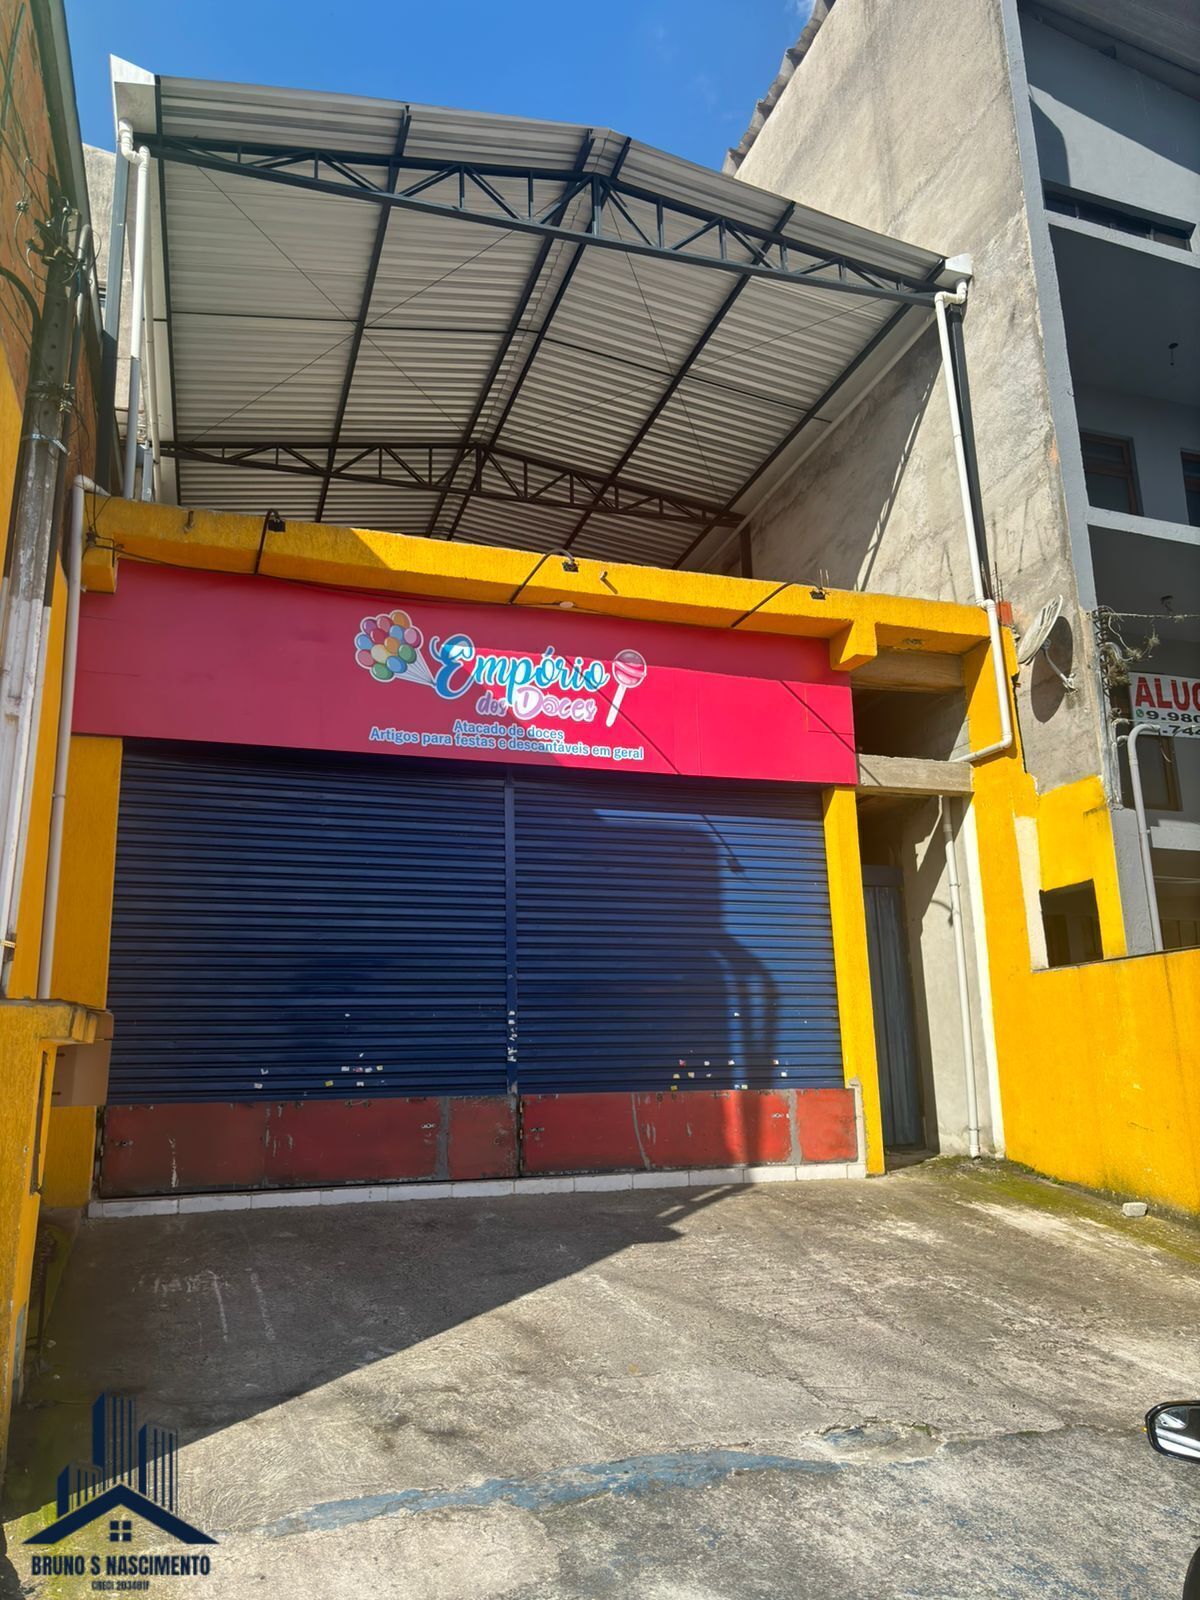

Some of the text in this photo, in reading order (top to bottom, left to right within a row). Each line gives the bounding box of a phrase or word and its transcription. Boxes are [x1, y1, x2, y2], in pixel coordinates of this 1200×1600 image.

[429, 634, 609, 704] Empório
[476, 691, 507, 716] dos
[369, 726, 644, 760] Artigos para festas e descantáveis em geral
[453, 720, 565, 740] Atacado de doces
